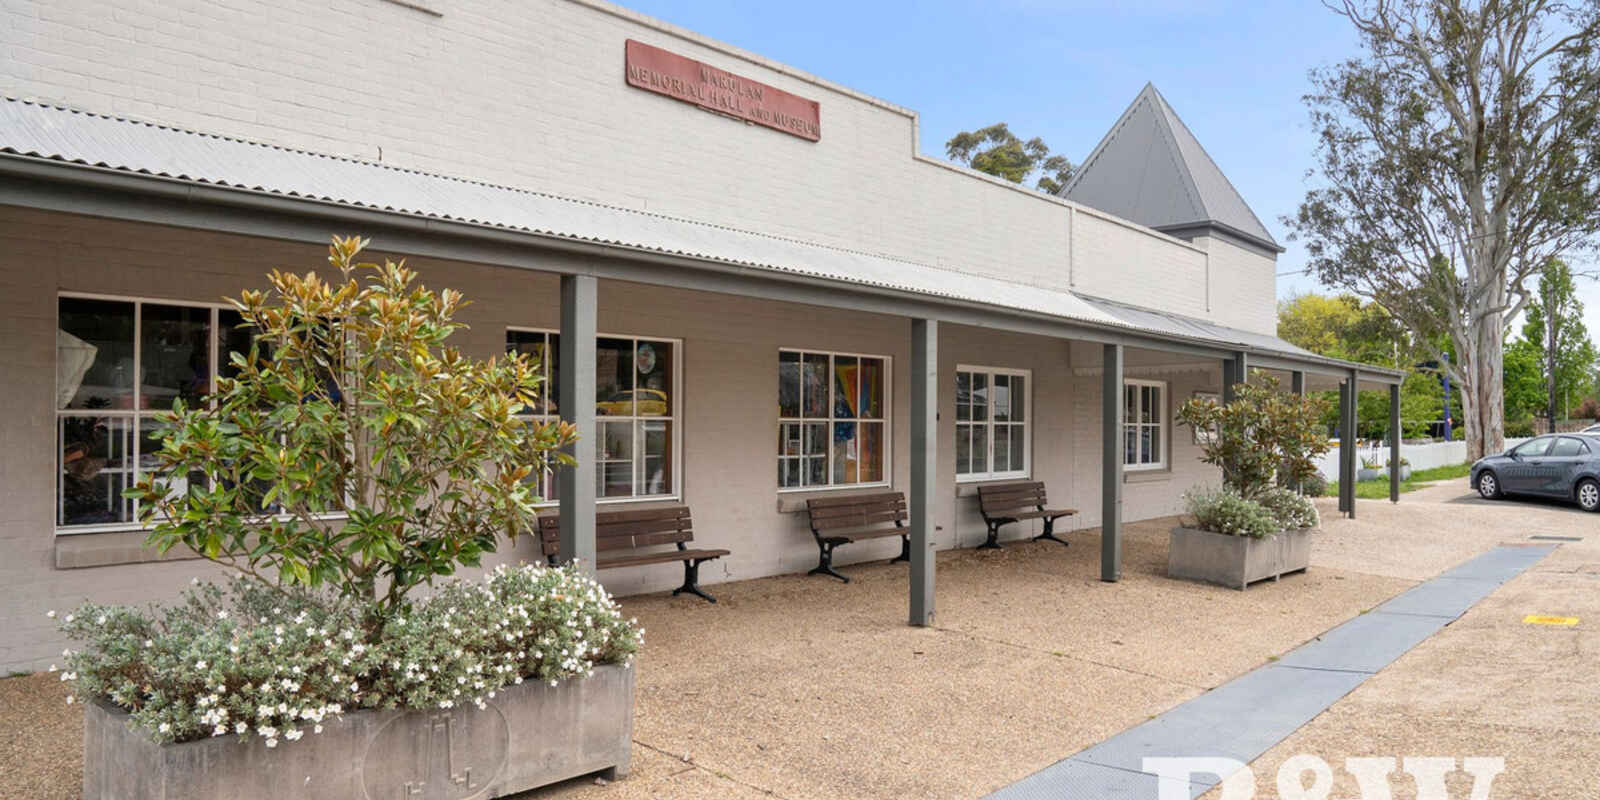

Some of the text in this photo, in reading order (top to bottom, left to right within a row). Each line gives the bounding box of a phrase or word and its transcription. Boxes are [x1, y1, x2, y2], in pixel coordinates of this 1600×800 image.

[629, 65, 819, 137] MEMORIAL HALL AND MUSEUM
[700, 67, 763, 101] MARULAN
